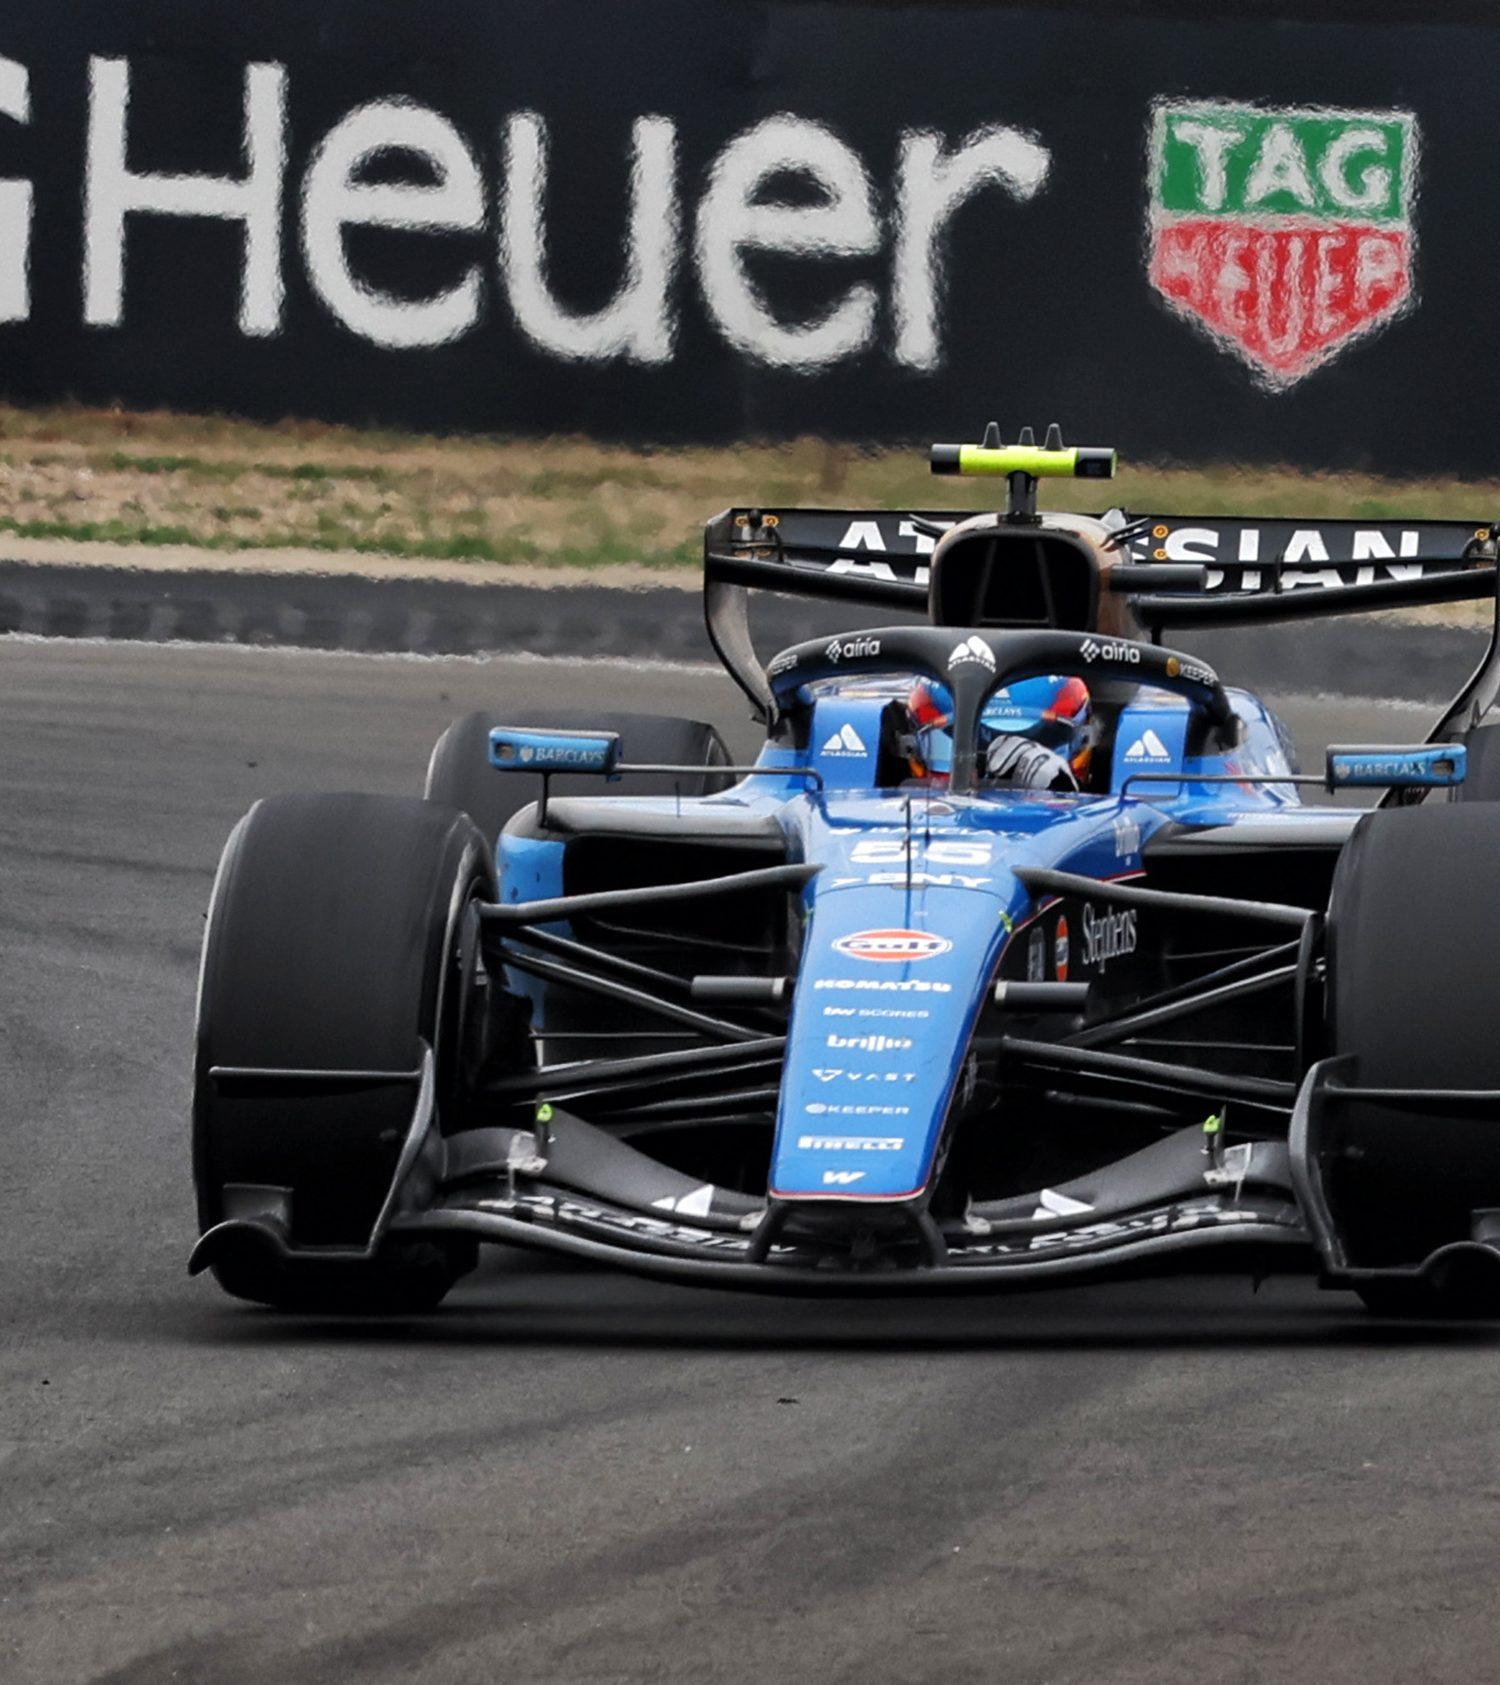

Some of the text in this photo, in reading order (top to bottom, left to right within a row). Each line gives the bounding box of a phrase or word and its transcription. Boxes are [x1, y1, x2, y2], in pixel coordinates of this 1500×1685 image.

[1172, 121, 1394, 210] TAG
[1157, 225, 1407, 354] HEUER
[843, 637, 881, 659] airia
[1101, 641, 1141, 664] airia
[534, 747, 605, 763] BARCLAYS
[1353, 762, 1427, 777] BARCLAYS
[849, 840, 993, 865] 55
[868, 872, 993, 888] BNY
[839, 938, 945, 950] Gulf
[813, 979, 952, 993] KOMATSU
[846, 1072, 917, 1082] VAST
[827, 1105, 910, 1115] KEEPER
[797, 1136, 905, 1151] PIRELLI
